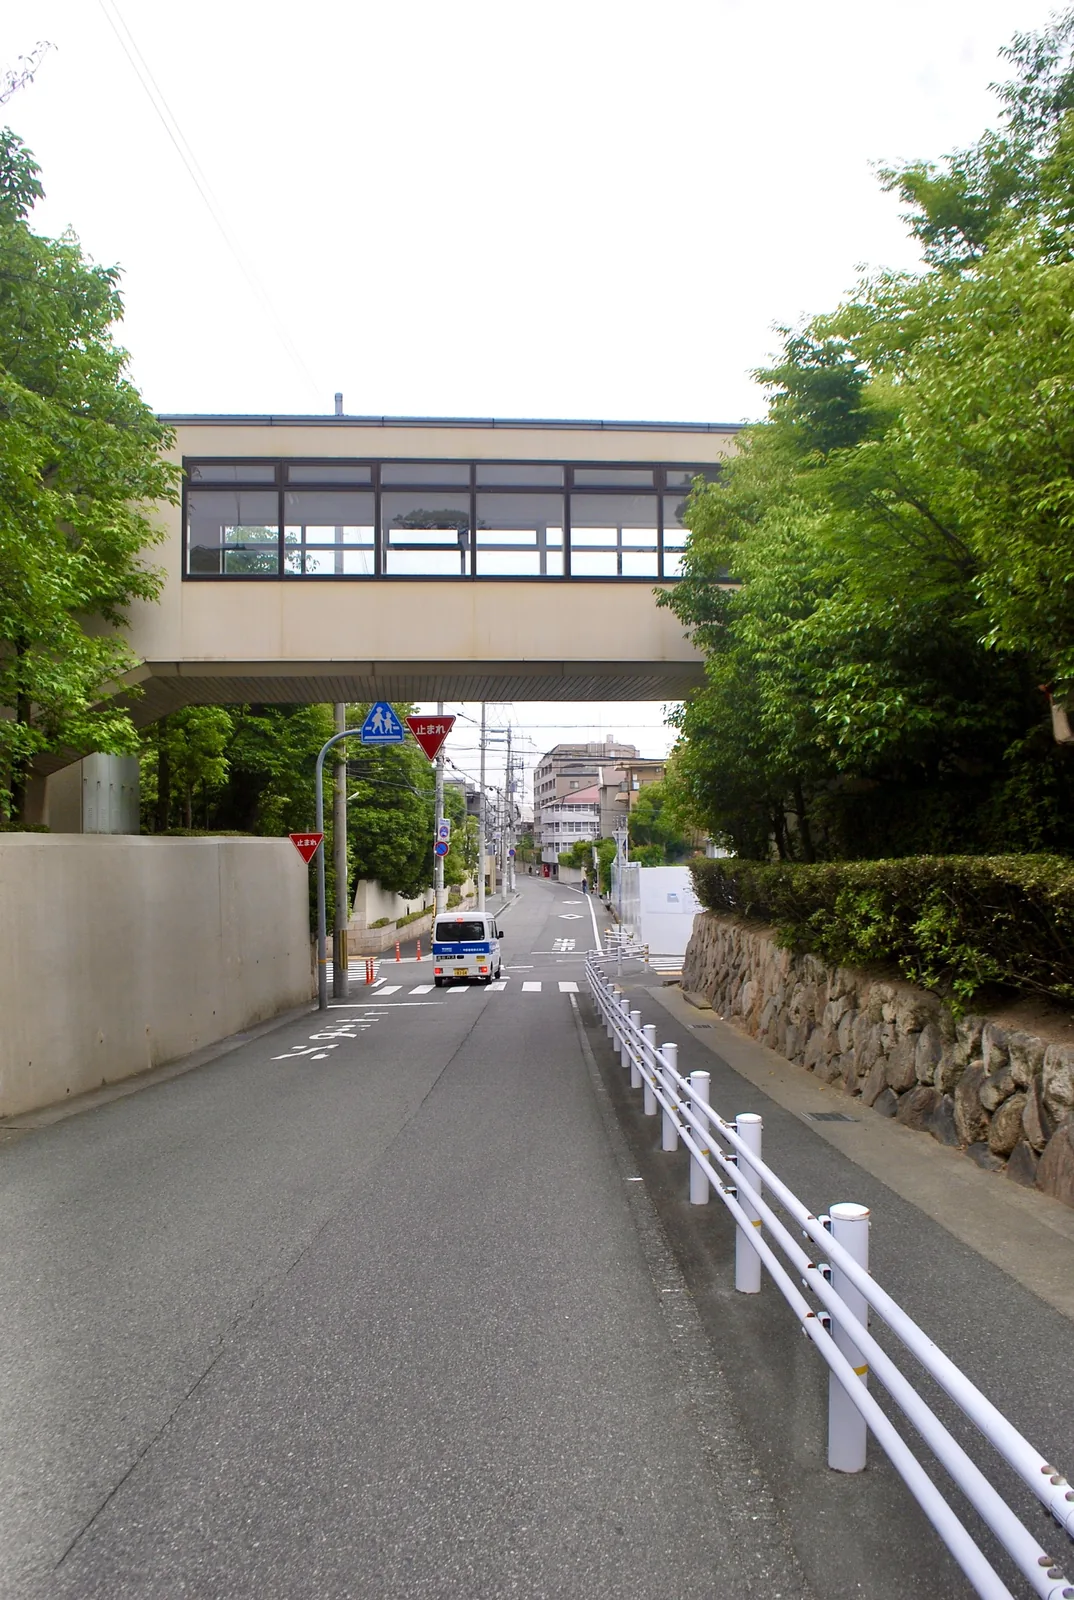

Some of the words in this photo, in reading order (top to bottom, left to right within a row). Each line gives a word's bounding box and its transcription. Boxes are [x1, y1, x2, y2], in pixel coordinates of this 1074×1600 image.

[416, 724, 446, 735] 止まれ
[297, 839, 317, 847] 止まれ
